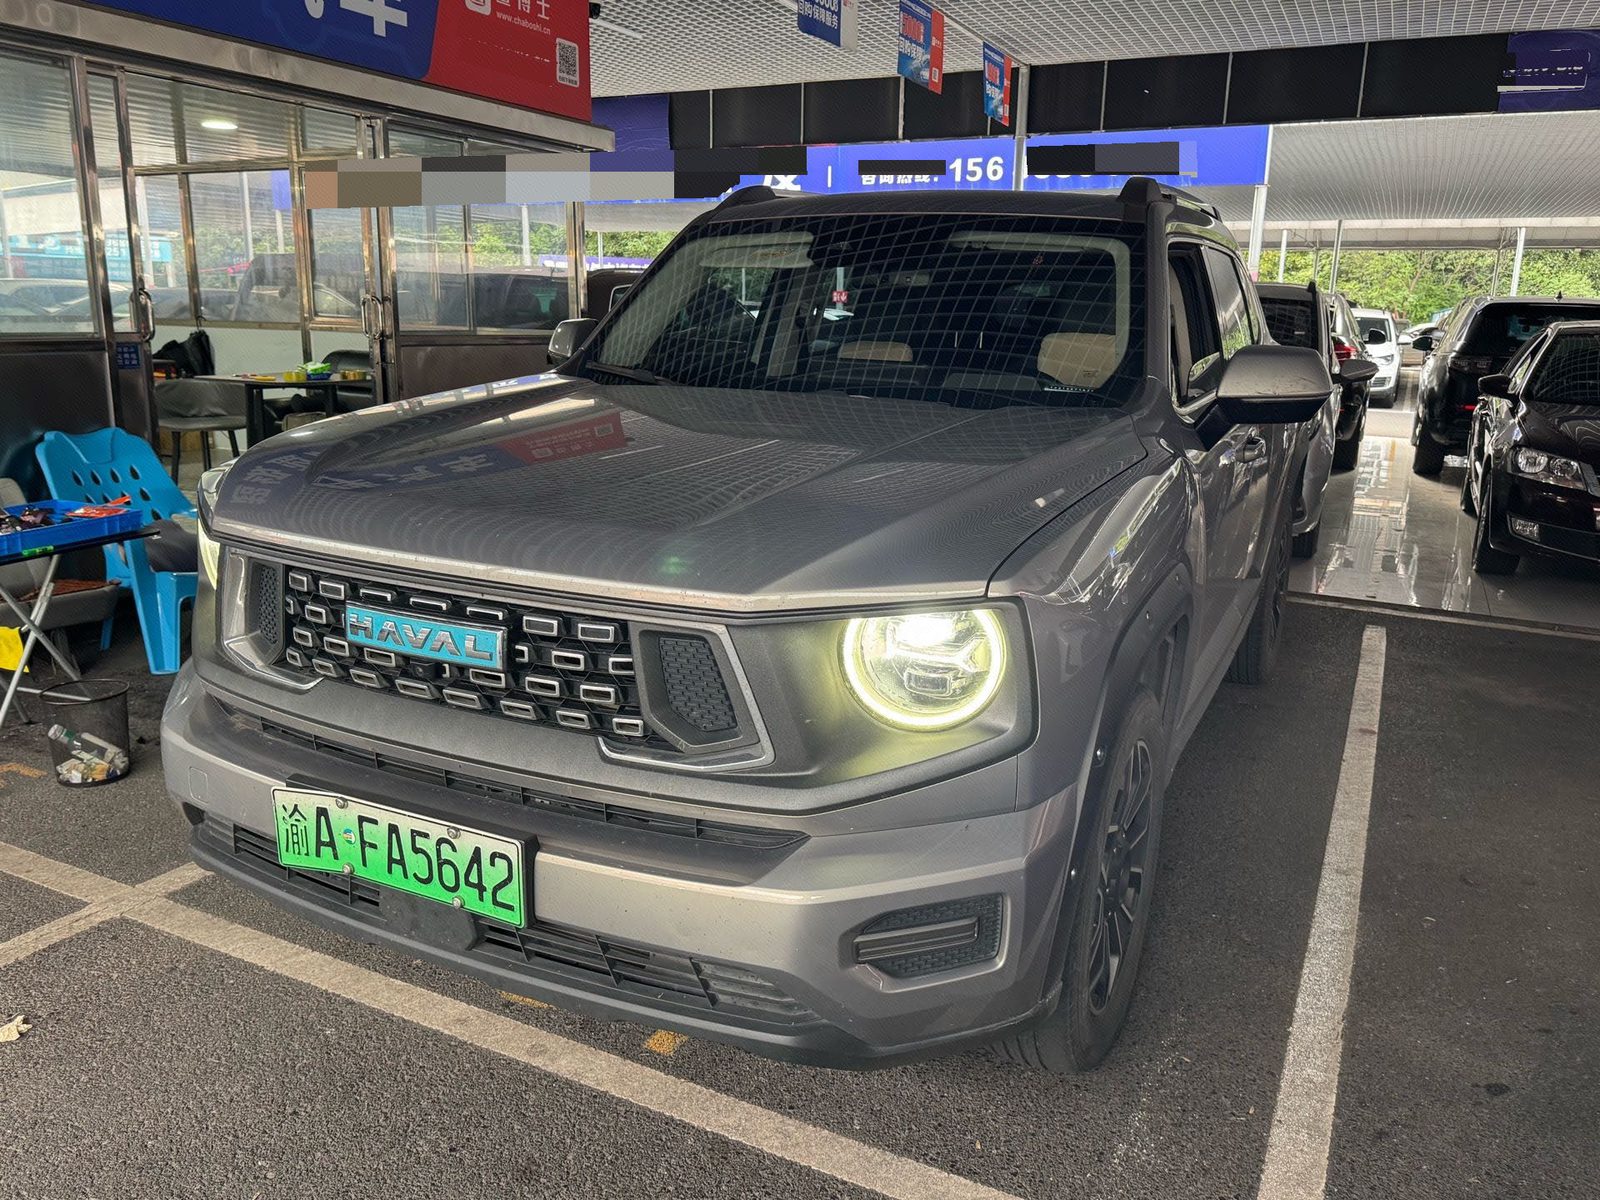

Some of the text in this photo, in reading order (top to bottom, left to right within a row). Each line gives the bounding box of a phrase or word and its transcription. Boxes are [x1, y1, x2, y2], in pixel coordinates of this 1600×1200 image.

[496, 10, 551, 35] www.chaboshi.cn
[948, 156, 1005, 183] 156
[348, 612, 493, 661] HAVAL
[282, 802, 516, 912] 渝A FA5642
